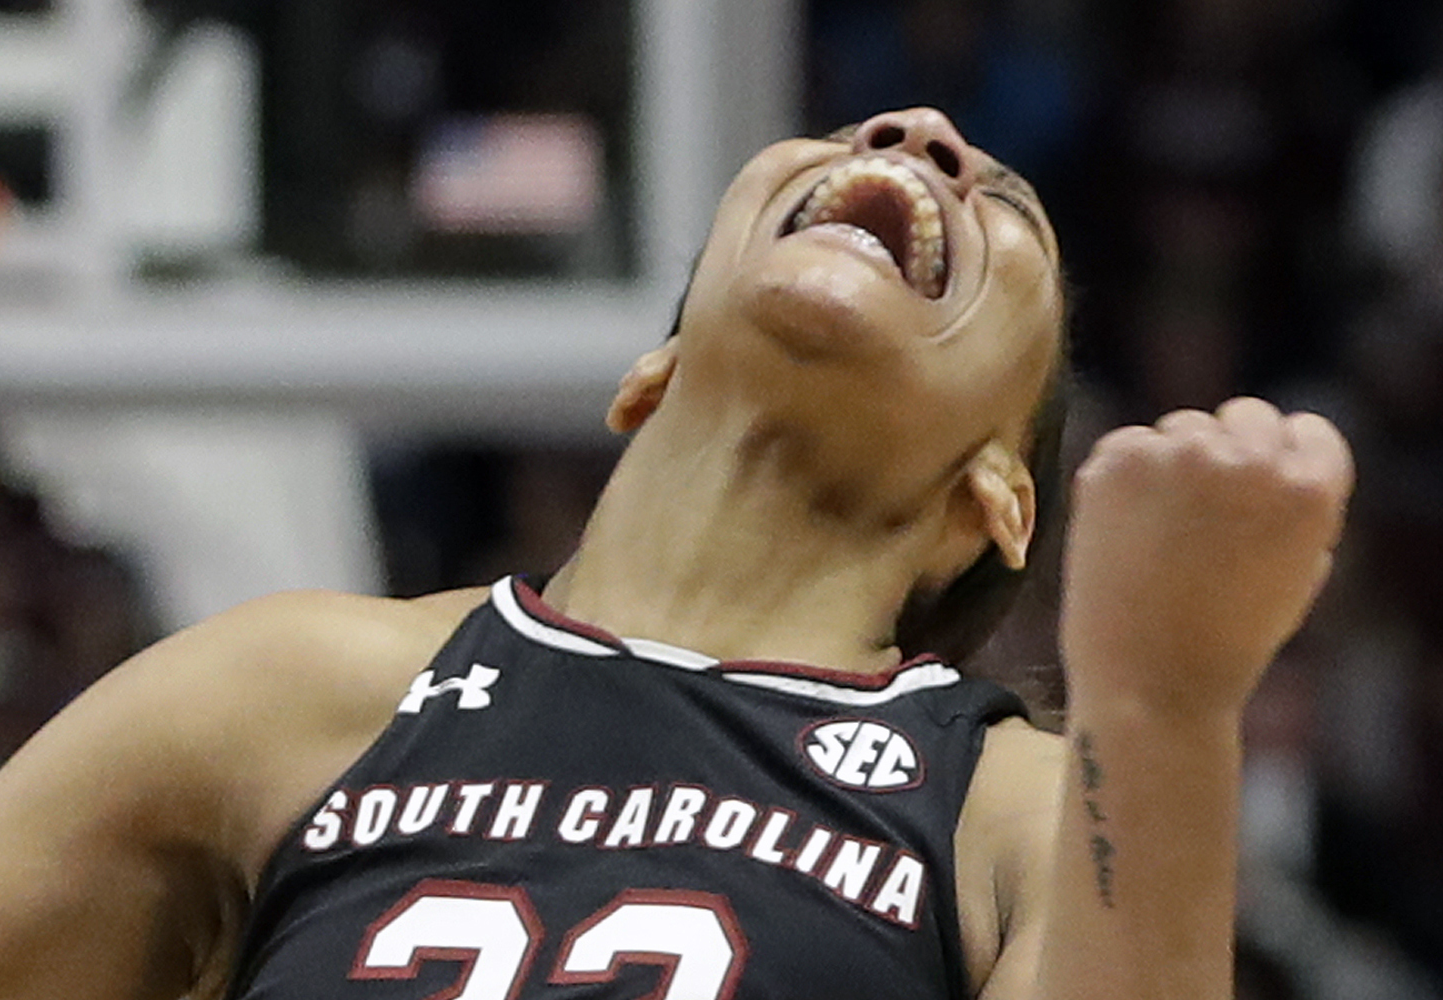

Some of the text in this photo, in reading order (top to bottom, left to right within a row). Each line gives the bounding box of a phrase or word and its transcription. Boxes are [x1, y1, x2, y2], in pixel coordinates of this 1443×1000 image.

[807, 721, 917, 787] SEC
[302, 780, 926, 927] SOUTH CAROLINA
